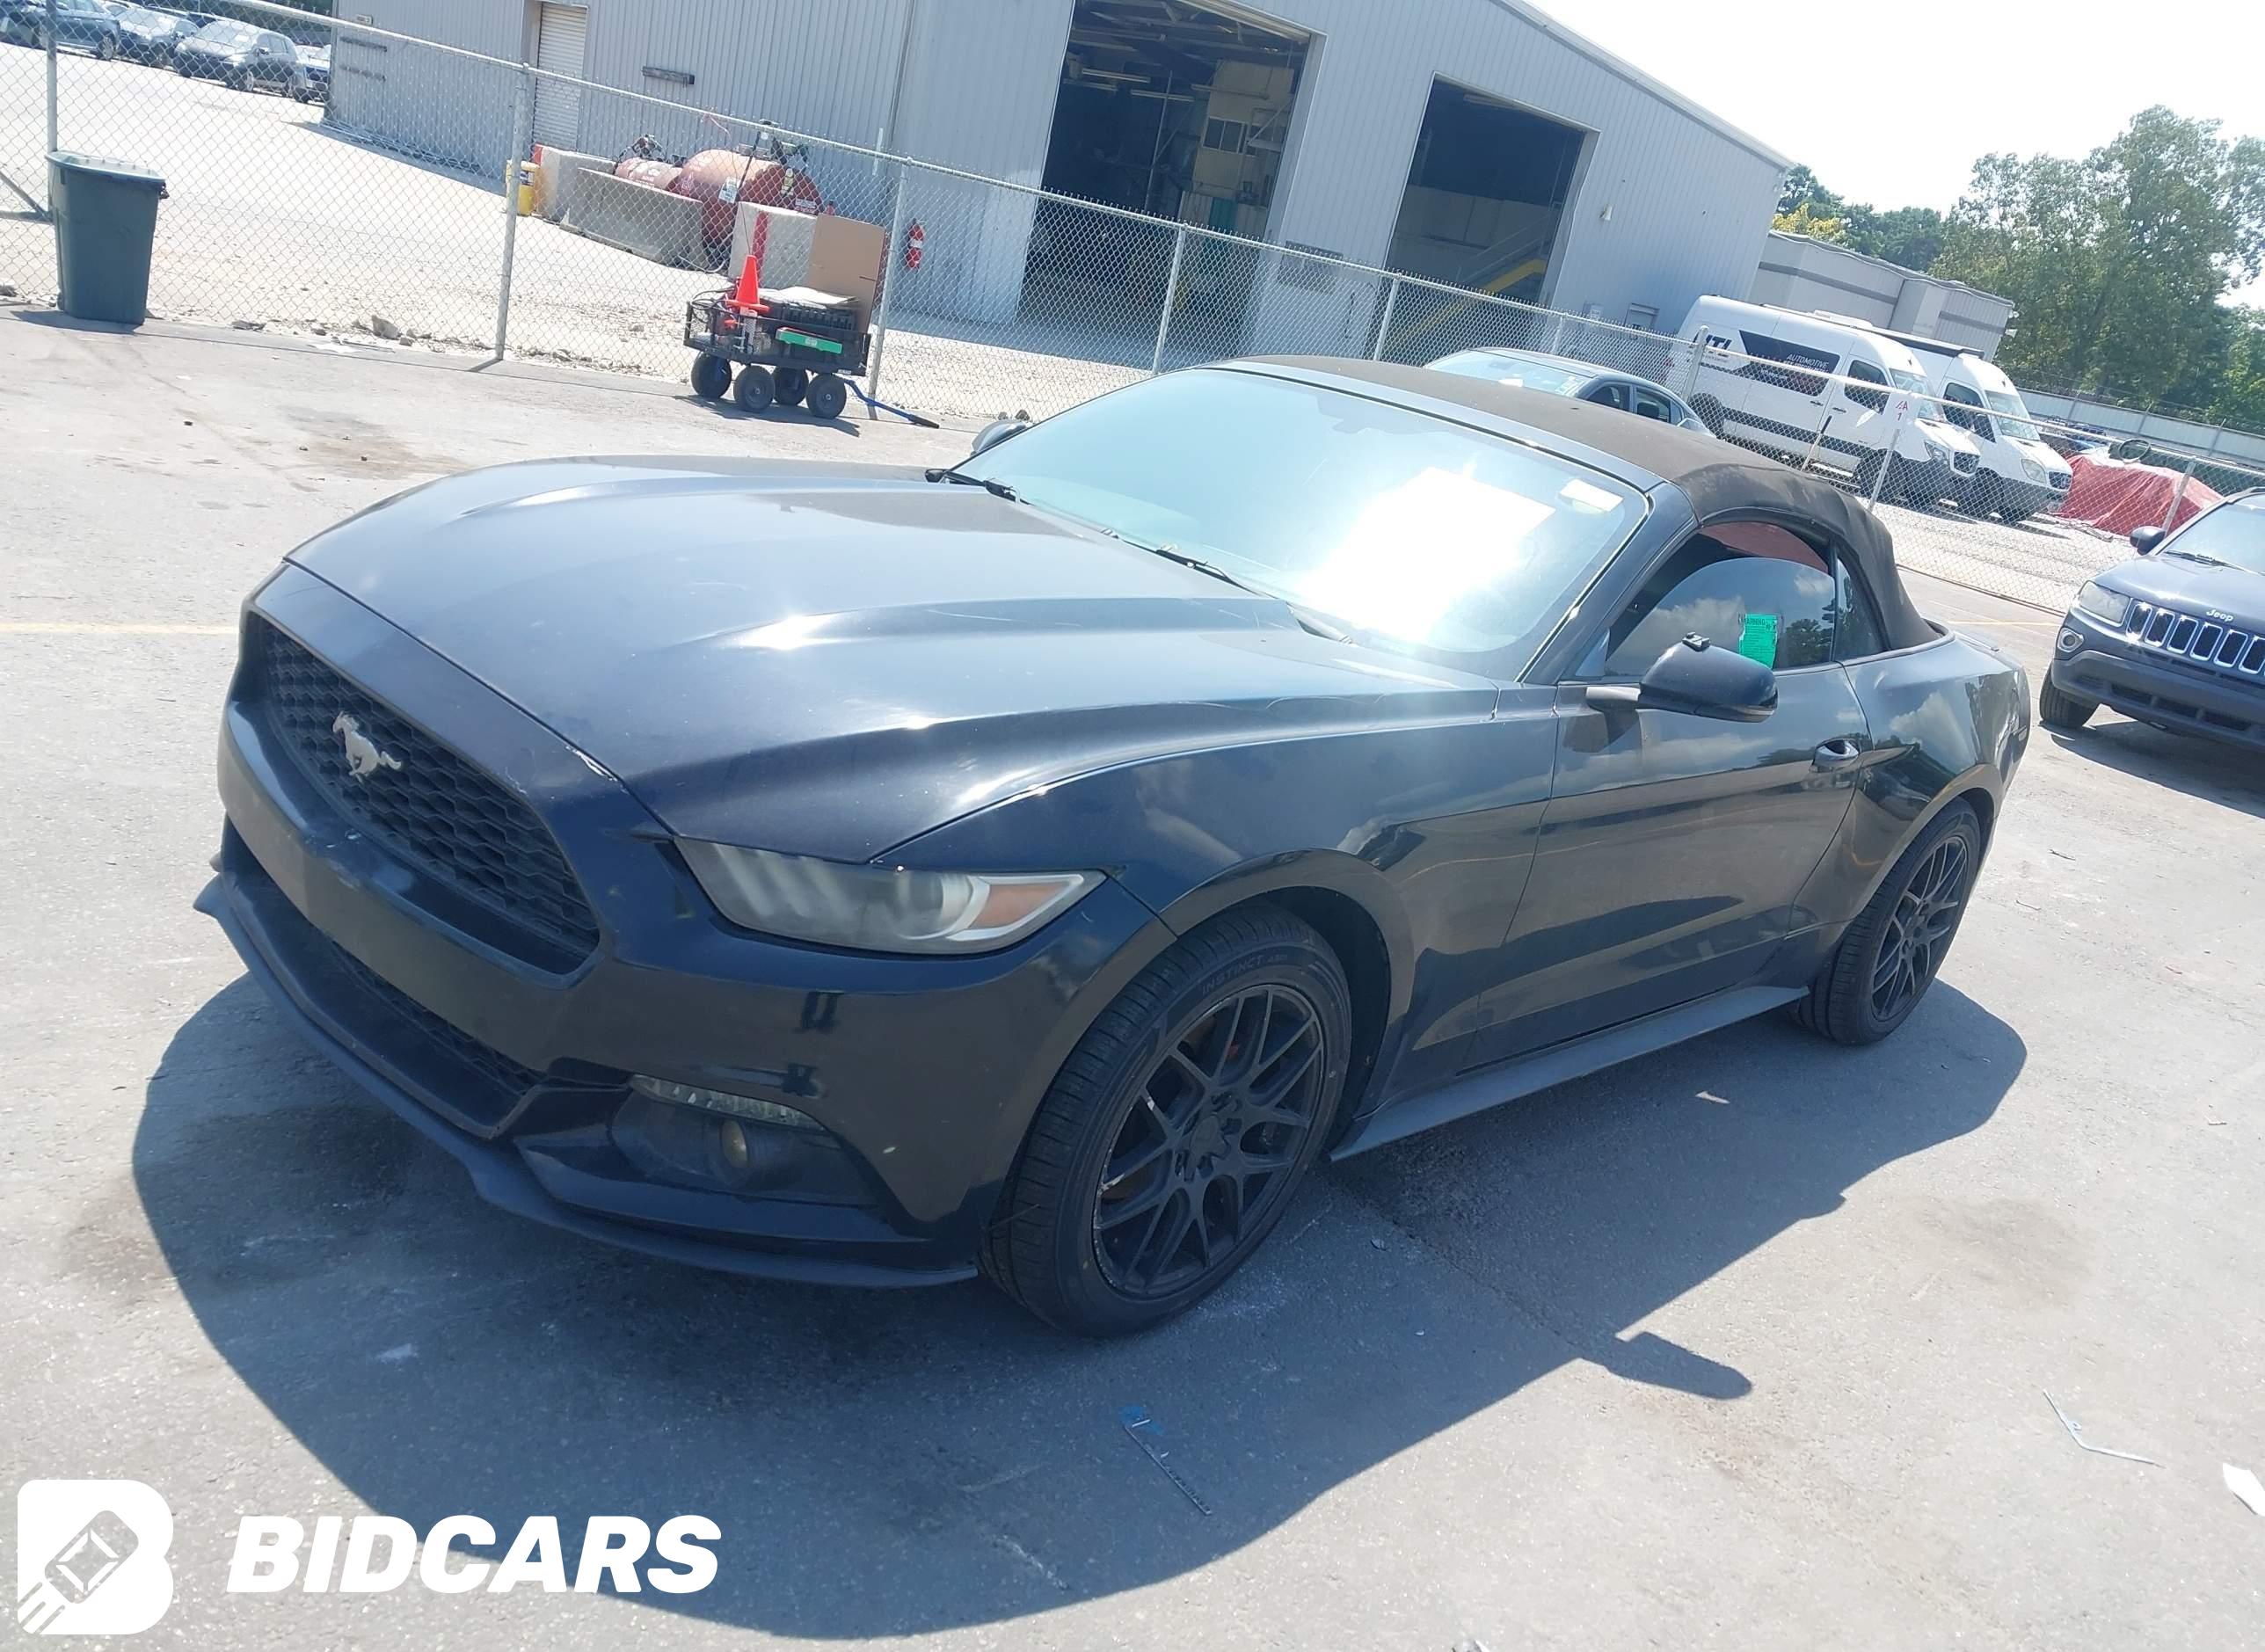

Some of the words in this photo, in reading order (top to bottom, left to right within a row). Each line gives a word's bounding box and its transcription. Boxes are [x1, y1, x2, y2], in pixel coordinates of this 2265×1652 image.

[1786, 353, 1829, 369] AUTOMOTIVE
[2206, 609, 2233, 622] Jeep
[1202, 954, 1264, 996] INSTINCT
